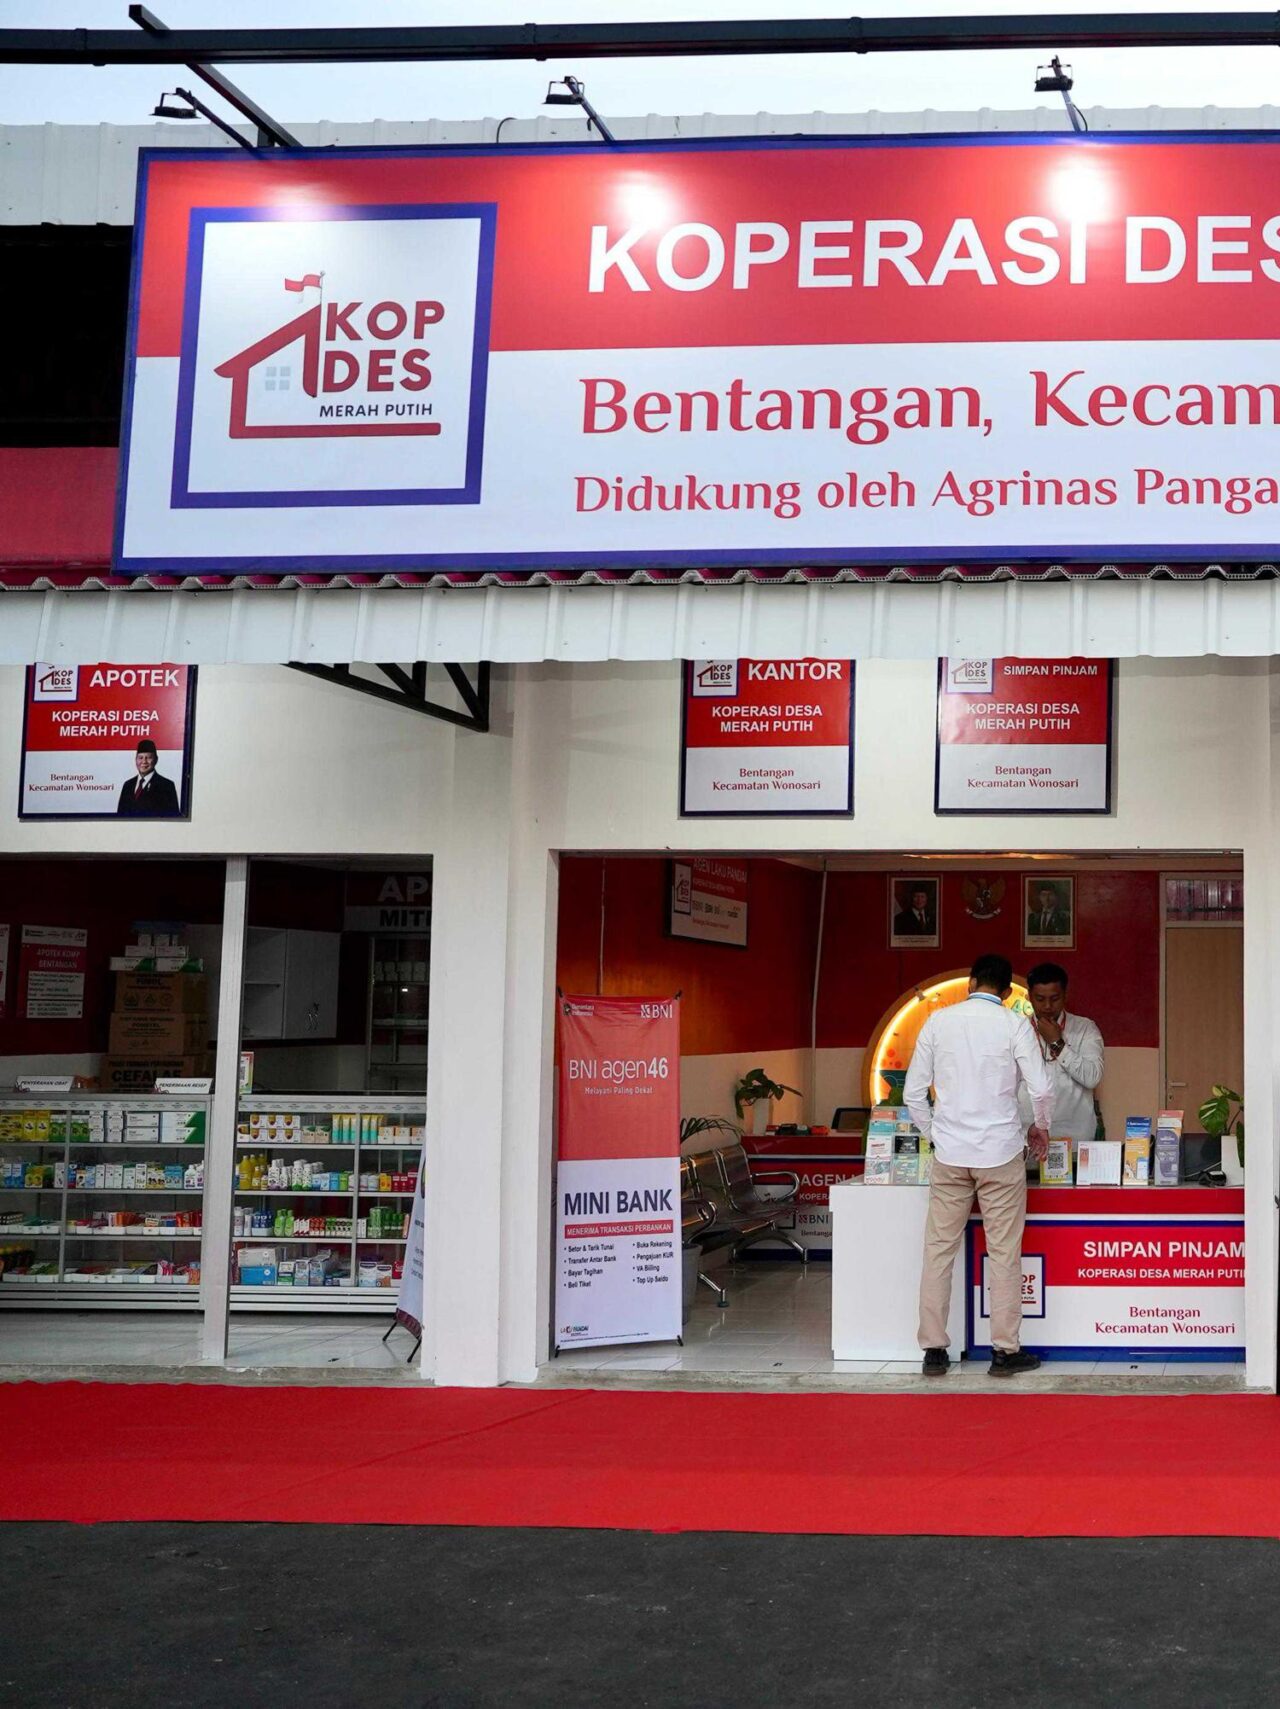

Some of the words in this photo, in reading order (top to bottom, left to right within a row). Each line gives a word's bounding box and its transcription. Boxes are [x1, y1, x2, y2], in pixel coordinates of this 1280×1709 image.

[587, 216, 1088, 294] KOPERASI
[325, 300, 445, 342] KOP
[321, 348, 432, 393] DES
[319, 404, 379, 418] MERAH
[385, 403, 433, 416] PUTIH
[579, 377, 993, 445] Bentangan,
[574, 474, 801, 519] Didukung
[817, 471, 916, 508] oleh
[932, 469, 1117, 517] Agrinas
[713, 664, 732, 672] KOP
[748, 662, 842, 680] KANTOR
[968, 661, 987, 669] KOP
[1003, 665, 1049, 676] SIMPAN
[1052, 665, 1098, 675] PINJAM
[89, 669, 180, 687] APOTEK
[713, 672, 731, 680] DES
[712, 705, 781, 717] KOPERASI
[785, 705, 822, 716] DESA
[966, 703, 1038, 714] KOPERASI
[1042, 703, 1080, 714] DESA
[52, 711, 119, 722] KOPERASI
[123, 710, 159, 721] DESA
[720, 721, 769, 732] MERAH
[773, 720, 813, 731] PUTIH
[975, 719, 1025, 729] MERAH
[1029, 718, 1071, 729] PUTIH
[59, 726, 107, 736] MERAH
[111, 725, 149, 736] PUTIH
[739, 768, 794, 779] Bentangan
[995, 766, 1051, 776] Bentangan
[50, 774, 94, 783] Bentangan
[967, 778, 1025, 788] Kecamatan
[1028, 778, 1079, 788] Wonosari
[29, 784, 74, 792] Kecamatan
[76, 783, 114, 791] Wonosari
[712, 781, 769, 791] Kecamatan
[772, 780, 821, 790] Wonosari
[652, 1005, 673, 1018] BNI
[569, 1060, 597, 1079] BNI
[602, 1058, 668, 1083] agen46
[564, 1191, 609, 1216] MINI
[617, 1189, 673, 1213] BANK
[809, 1214, 829, 1224] BNI
[567, 1226, 599, 1235] MENERIMA
[600, 1225, 634, 1234] TRANSAKSI
[635, 1223, 671, 1232] PERBANKAN
[1083, 1241, 1162, 1258] SIMPAN
[1169, 1241, 1245, 1258] PINJAM
[1078, 1268, 1137, 1279] KOPERASI
[1140, 1268, 1170, 1279] DESA
[1173, 1268, 1214, 1278] MERAH
[1130, 1306, 1201, 1320] Bentangan
[1095, 1322, 1169, 1334] Kecamatan
[1173, 1322, 1235, 1334] Wonosari
